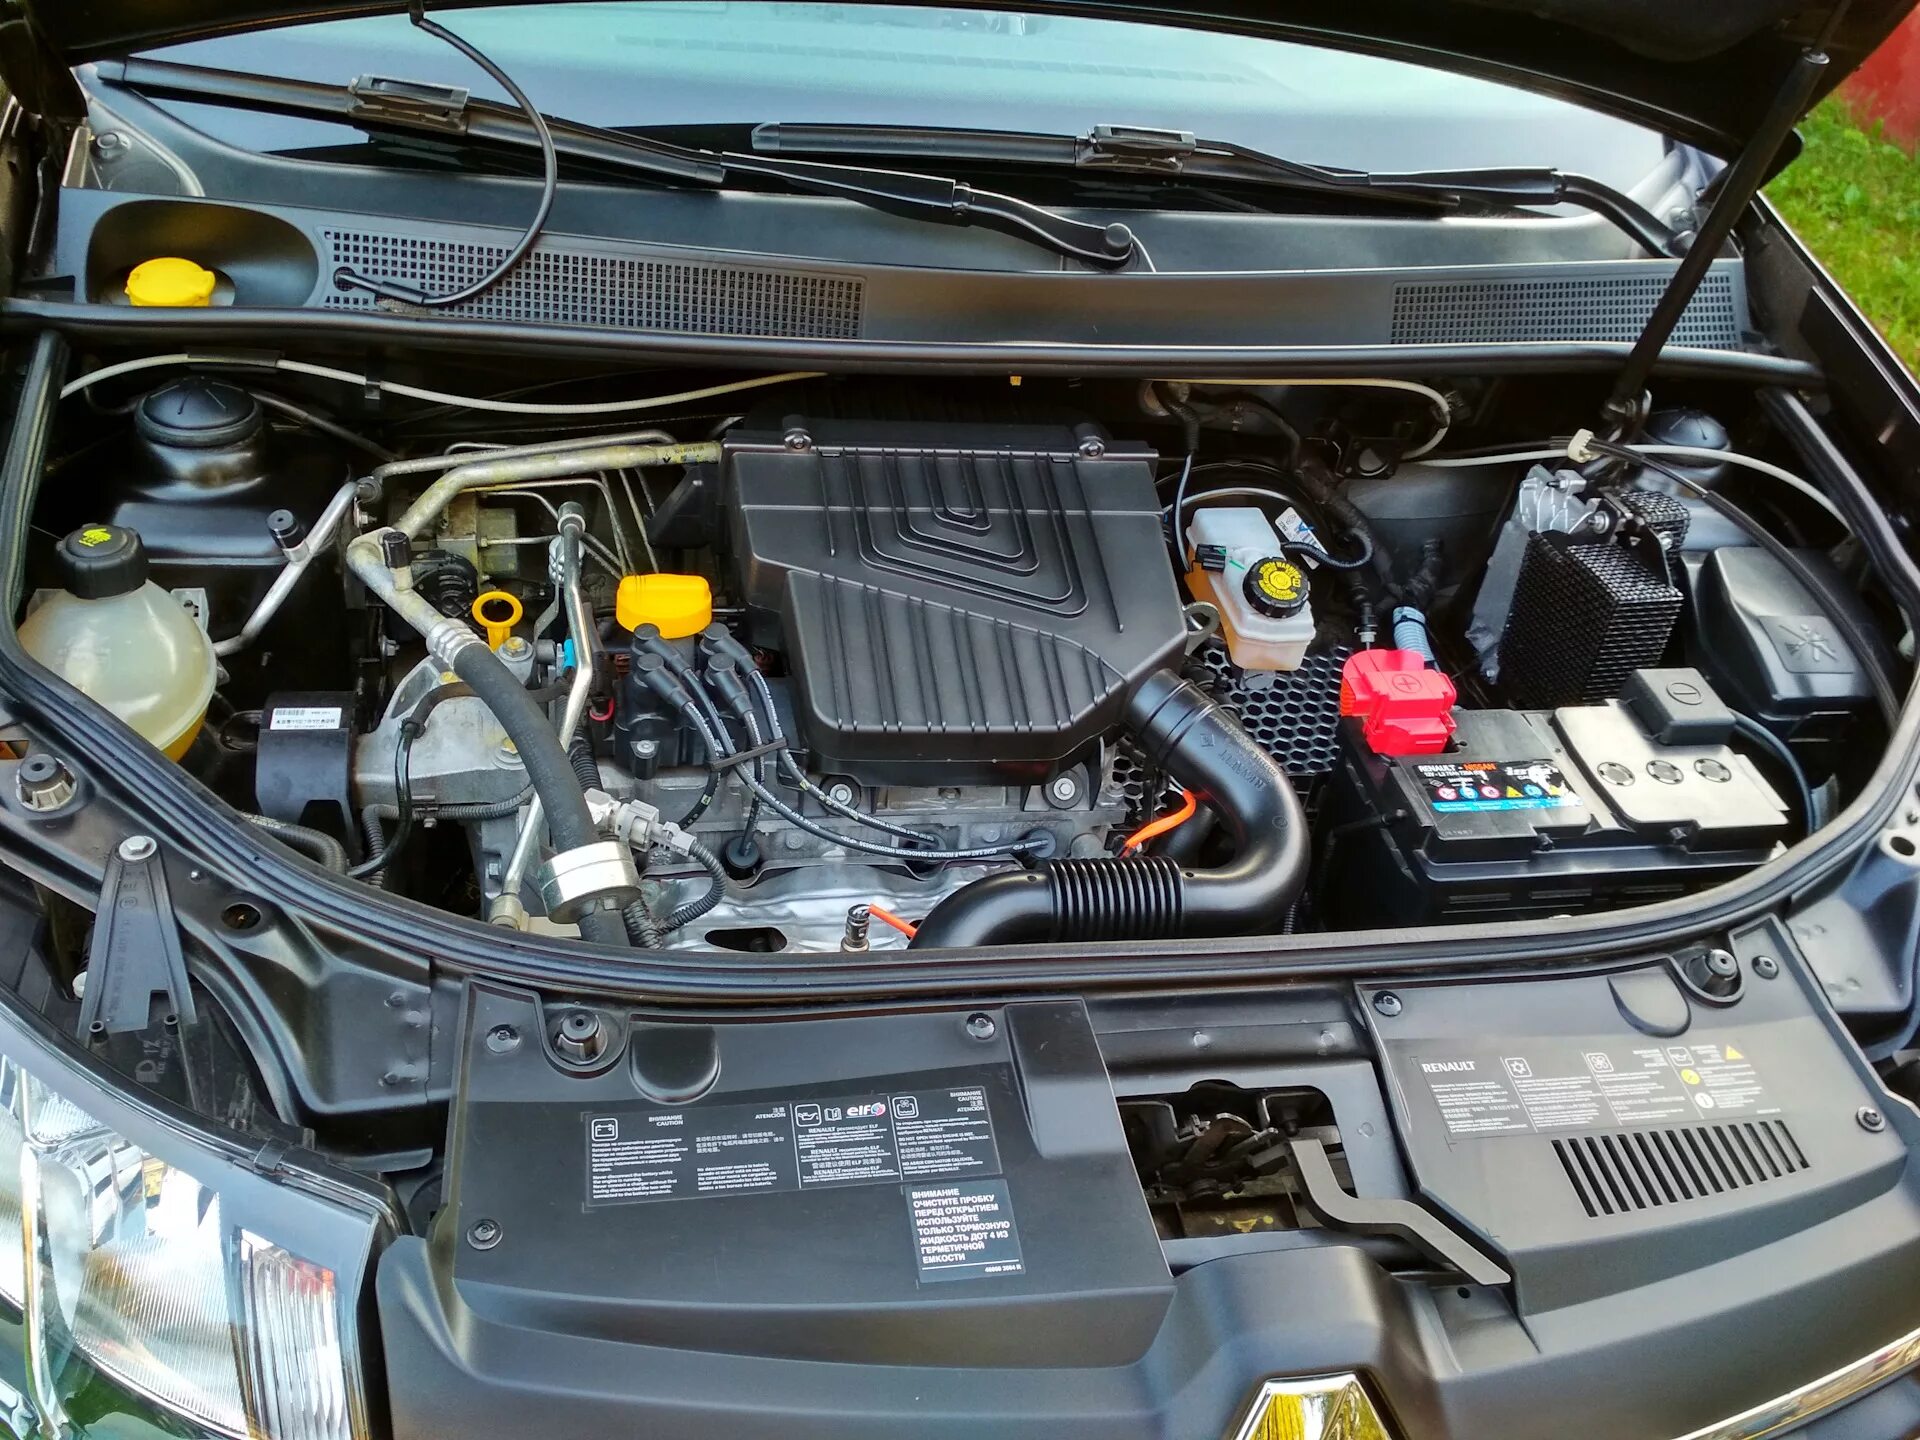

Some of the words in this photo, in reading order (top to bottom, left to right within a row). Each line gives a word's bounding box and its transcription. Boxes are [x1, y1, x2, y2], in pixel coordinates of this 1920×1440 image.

[1418, 764, 1456, 772] RENAULT
[1463, 763, 1496, 771] NISSAN
[1421, 1061, 1476, 1073] RENAULT
[912, 1188, 960, 1199] ВНИМАНИЕ
[913, 1197, 959, 1208] ОЧИСТИТЕ
[960, 1194, 995, 1204] ПРОБКУ
[914, 1207, 944, 1217] ПЕРЕД
[945, 1203, 999, 1215] ОТКРЫТИЕМ
[916, 1214, 979, 1226] ИСПОЛЬЗУЙТЕ
[917, 1224, 954, 1235] ТОЛЬКО
[955, 1221, 1010, 1232] ТОРМОЗНУЮ
[919, 1233, 969, 1245] ЖИДКОСТЬ
[970, 1231, 988, 1241] ДОТ
[989, 1231, 995, 1239] 4
[996, 1230, 1009, 1238] ИЗ
[921, 1241, 985, 1254] ГЕРМЕТИЧНОЙ
[922, 1253, 966, 1264] ЕМКОСТИ
